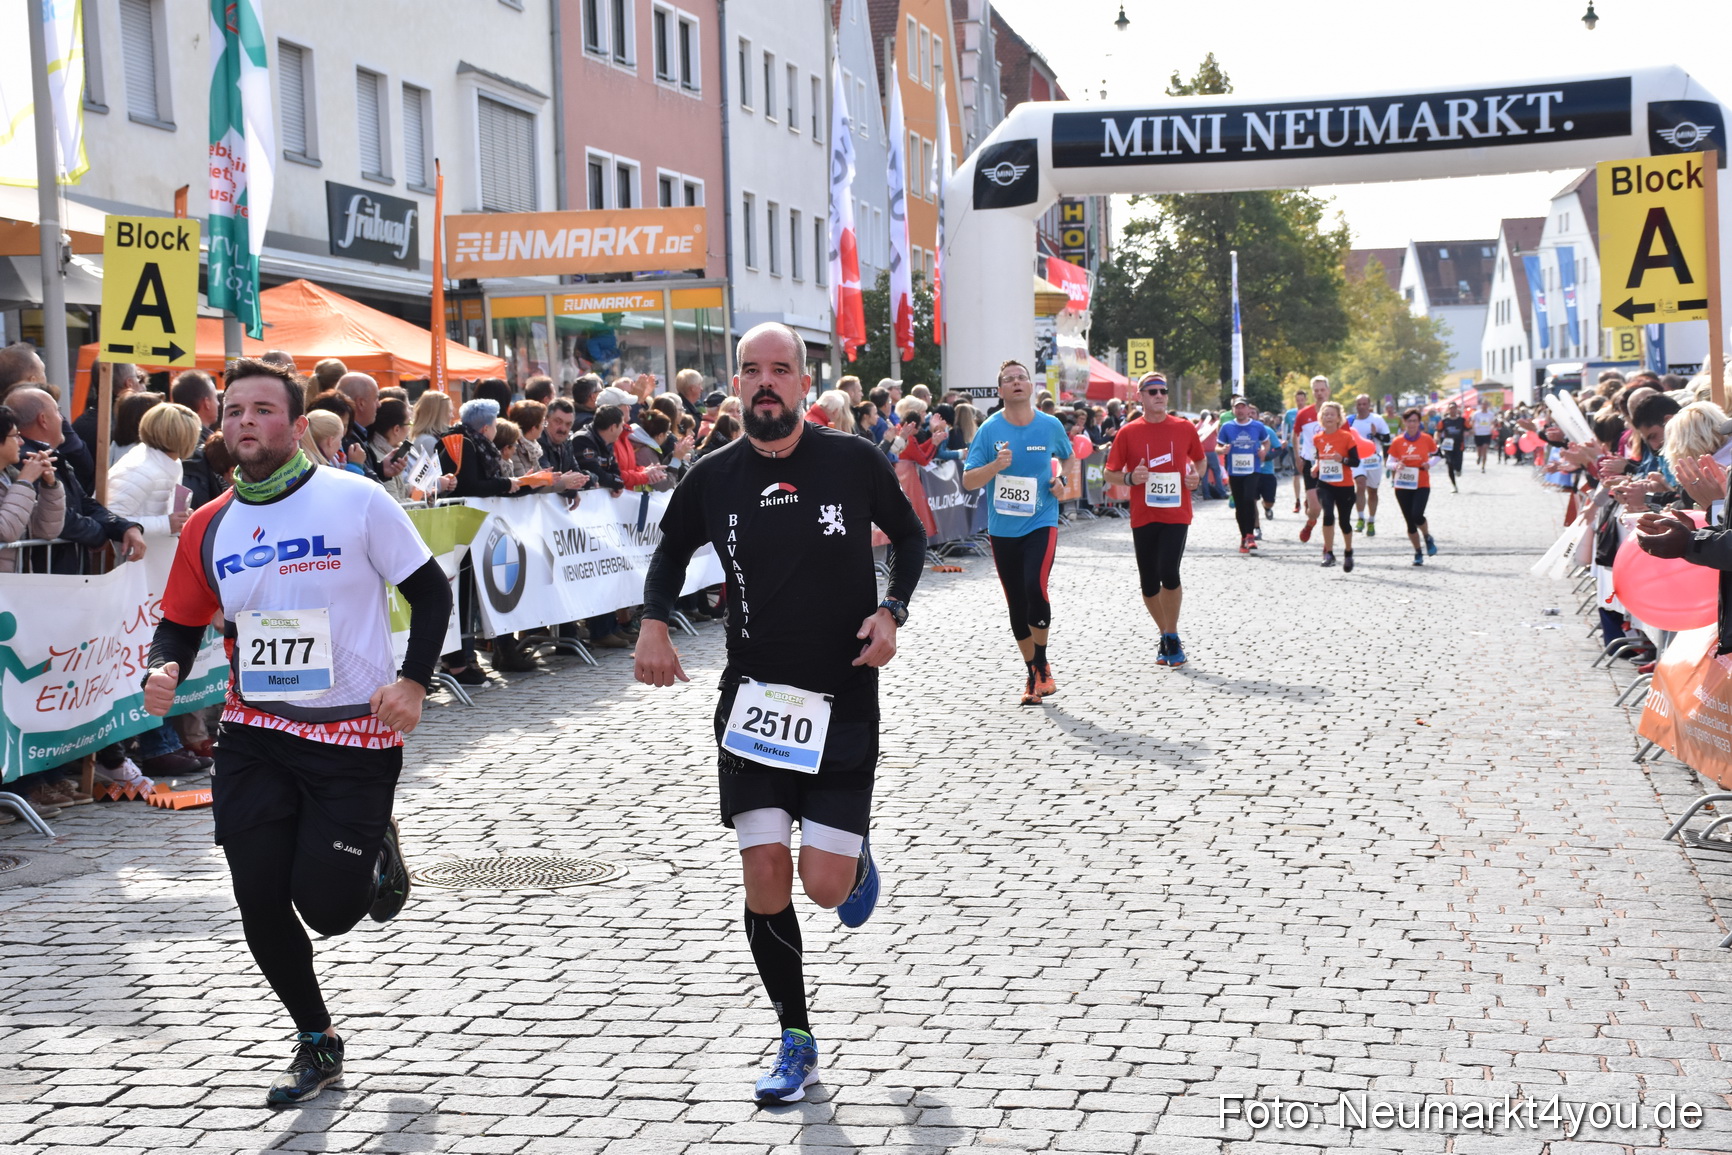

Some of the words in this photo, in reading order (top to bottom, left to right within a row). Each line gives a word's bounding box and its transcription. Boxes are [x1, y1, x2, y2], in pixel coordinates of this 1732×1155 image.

[1100, 113, 1227, 157] MINI
[1242, 91, 1575, 152] NEUMARKT.
[996, 169, 1014, 178] MINI
[1611, 160, 1704, 196] Block
[117, 222, 190, 251] Block
[455, 225, 694, 263] RUNMARKT.DE
[1626, 206, 1695, 289] A
[121, 262, 176, 334] A
[564, 296, 655, 311] RUNMARKT.DE
[1621, 333, 1635, 352] B
[1135, 351, 1147, 368] B
[965, 388, 999, 398] MINI-P
[1000, 487, 1030, 502] 2583
[1151, 483, 1176, 494] 2512
[760, 494, 799, 507] skinfit
[553, 527, 586, 557] BMW
[251, 638, 315, 665] 2177
[268, 675, 300, 685] Marcel
[742, 706, 812, 744] 2510
[28, 733, 97, 759] Service-Line:
[754, 742, 790, 757] Markus
[343, 845, 362, 855] JAKO
